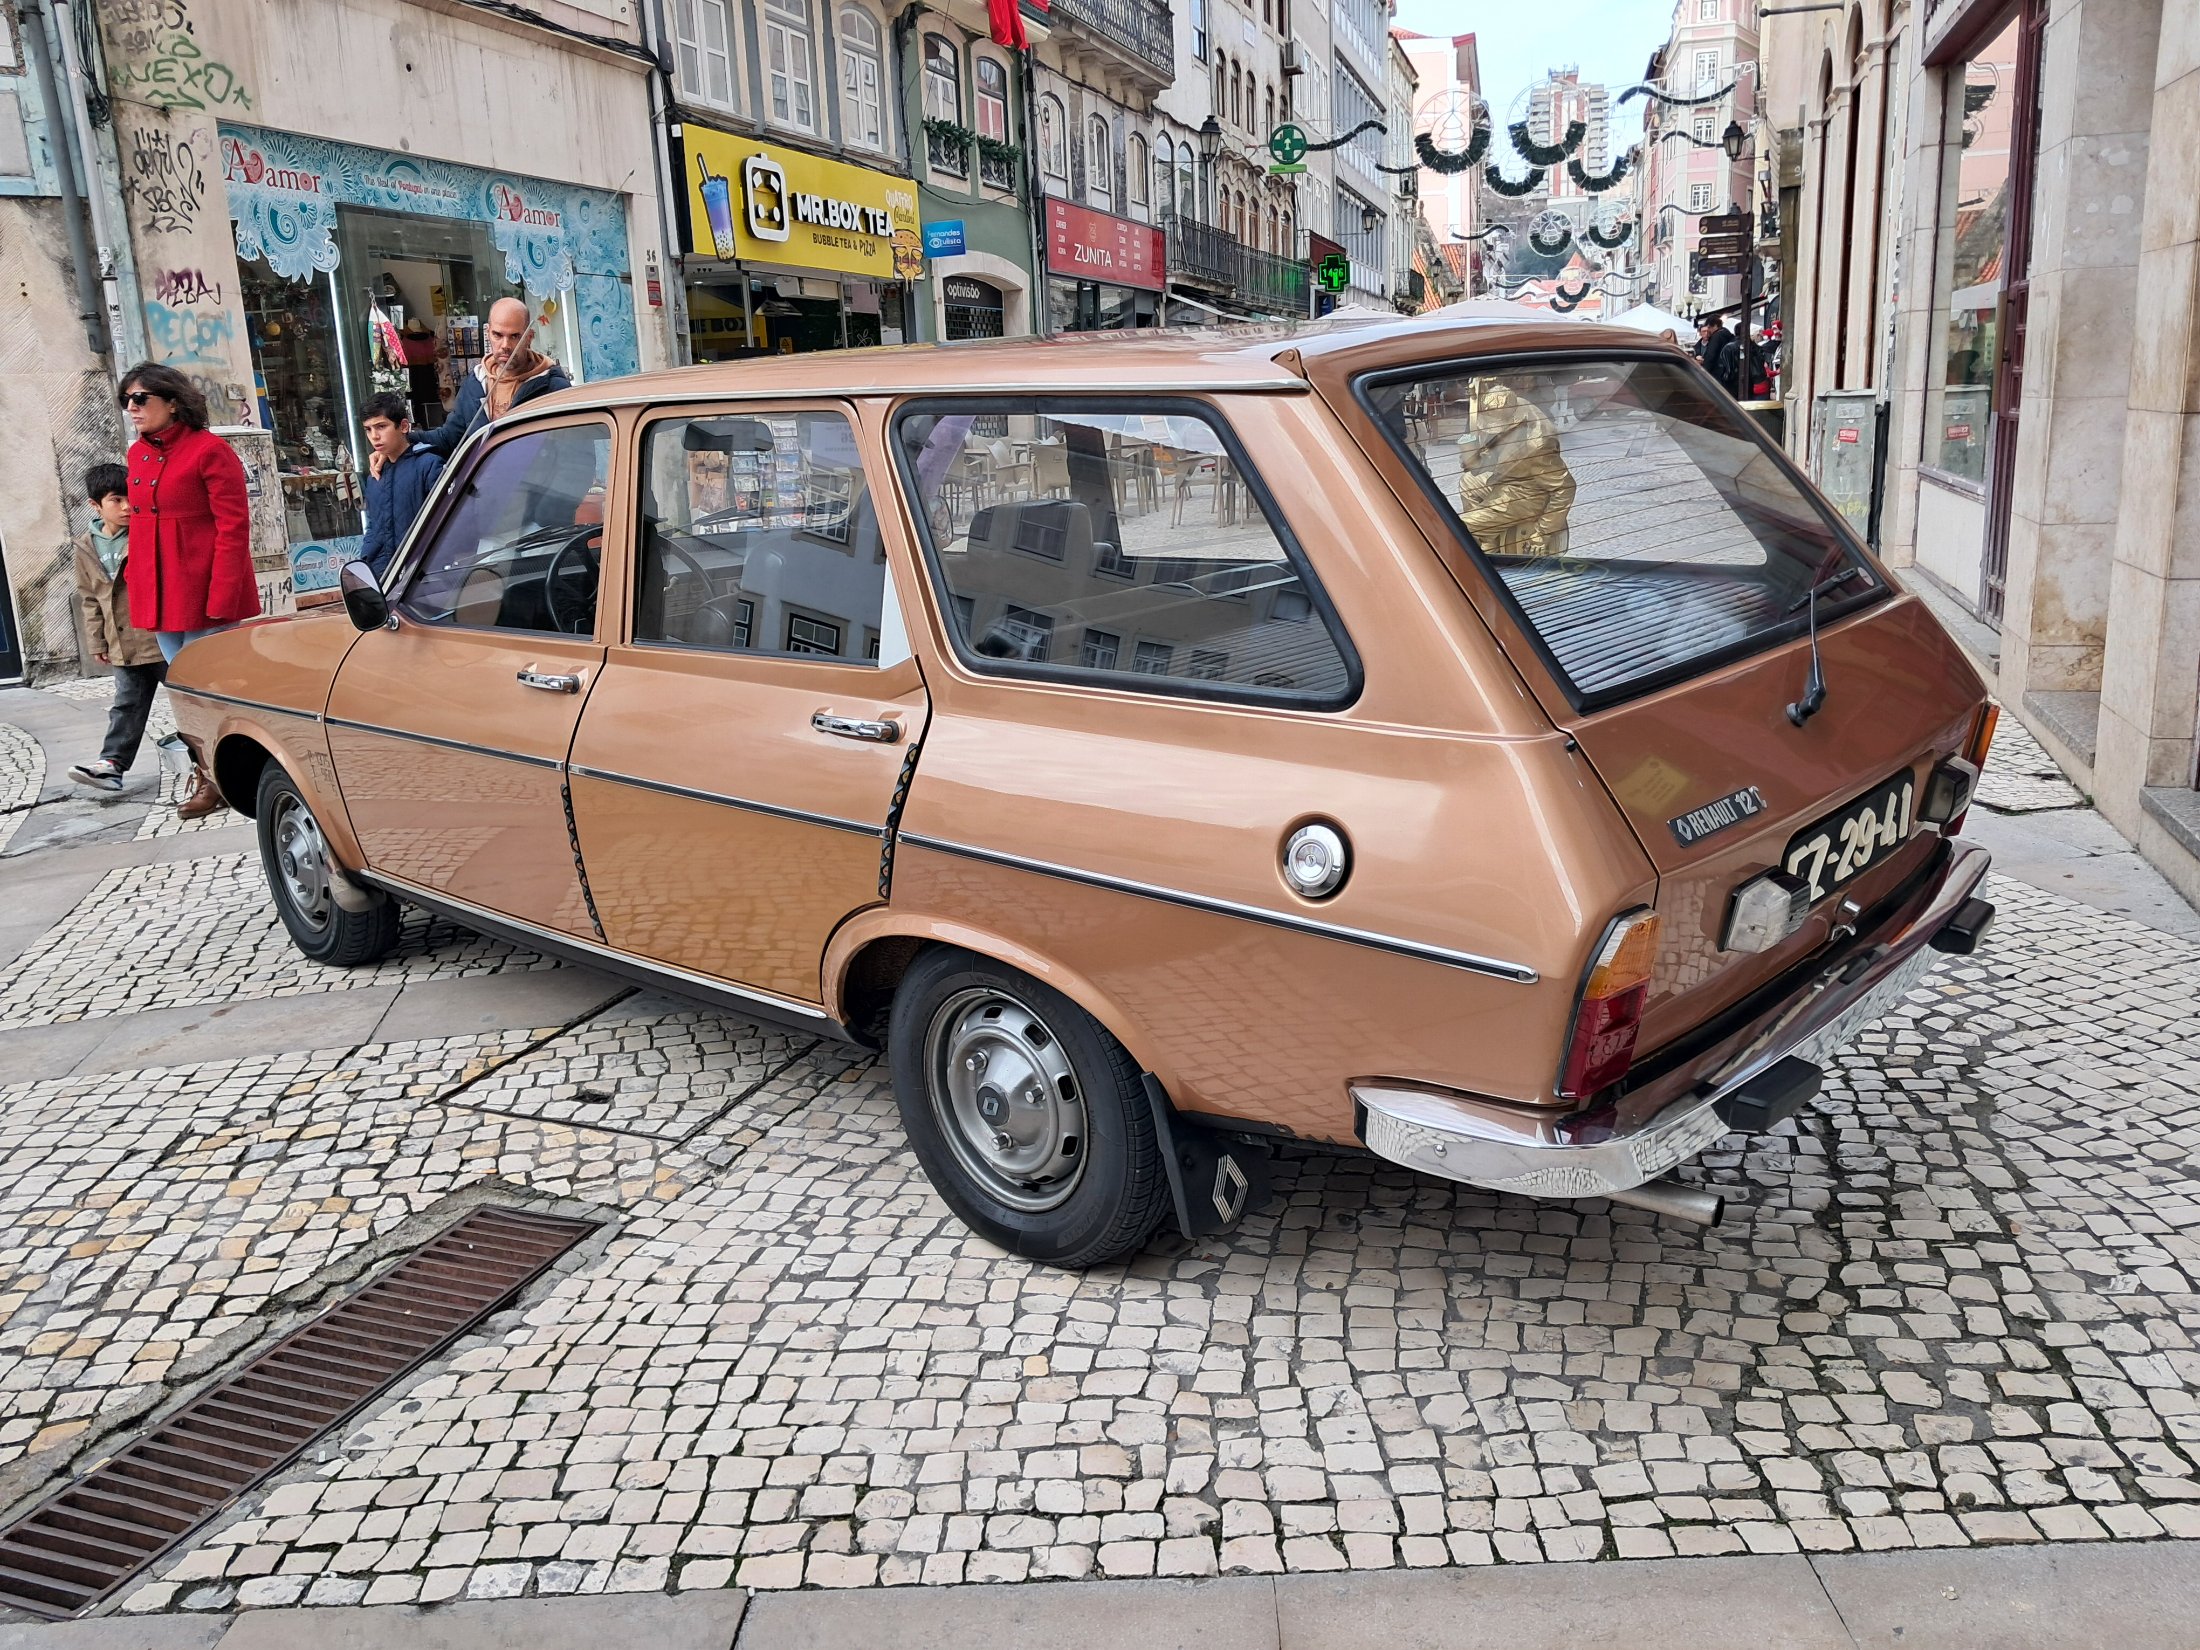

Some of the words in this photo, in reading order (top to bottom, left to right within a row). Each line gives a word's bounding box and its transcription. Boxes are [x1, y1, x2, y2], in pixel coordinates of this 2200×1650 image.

[863, 207, 896, 237] TEA
[927, 229, 960, 237] Fernandes
[646, 248, 657, 262] 56
[812, 232, 839, 247] BUBBLE
[840, 238, 852, 249] TEA
[859, 239, 877, 257] PIZZA
[1074, 243, 1112, 268] ZUNITA
[946, 282, 981, 299] optivisão
[1686, 797, 1739, 837] RENAULT
[1735, 791, 1758, 815] 12
